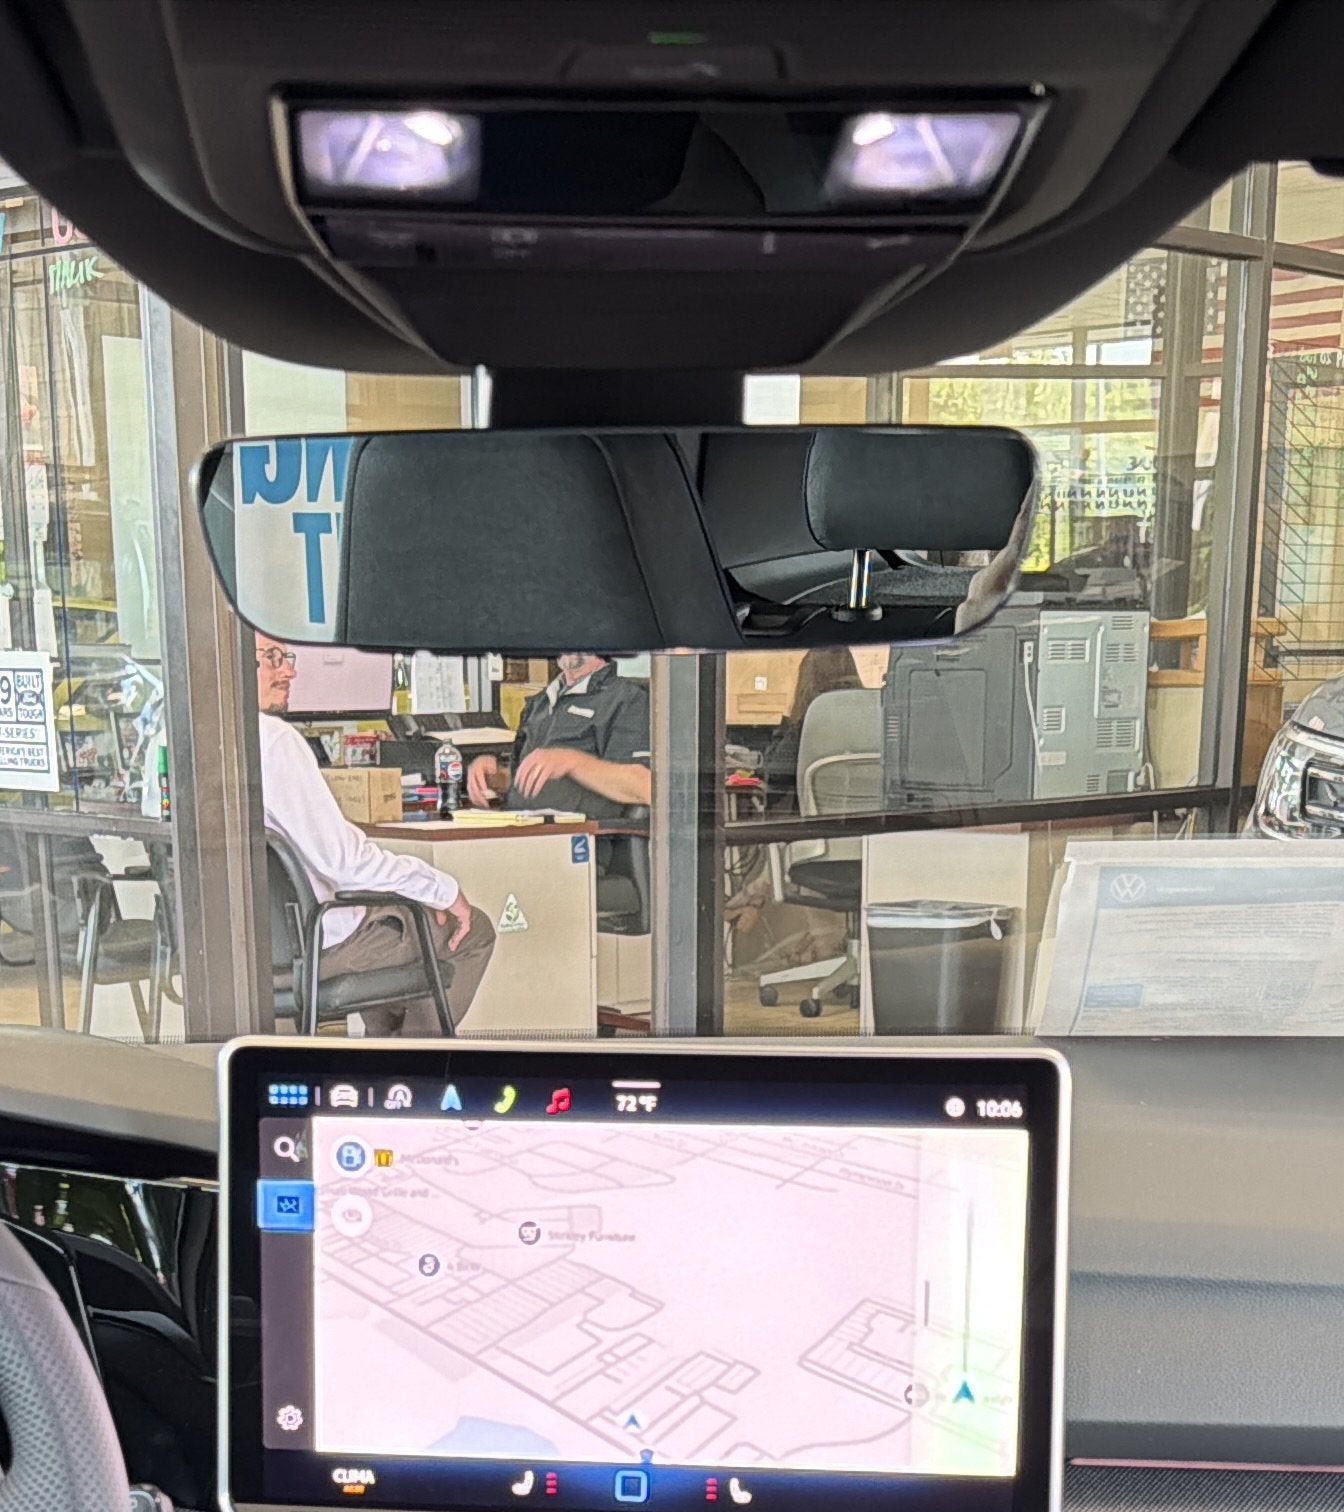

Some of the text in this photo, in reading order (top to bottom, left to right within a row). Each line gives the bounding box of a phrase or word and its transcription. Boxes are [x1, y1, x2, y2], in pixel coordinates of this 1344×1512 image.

[16, 674, 42, 689] BUILT
[616, 1094, 637, 1112] 72
[977, 1099, 1023, 1118] 10:06
[332, 1468, 376, 1485] CLIMA
